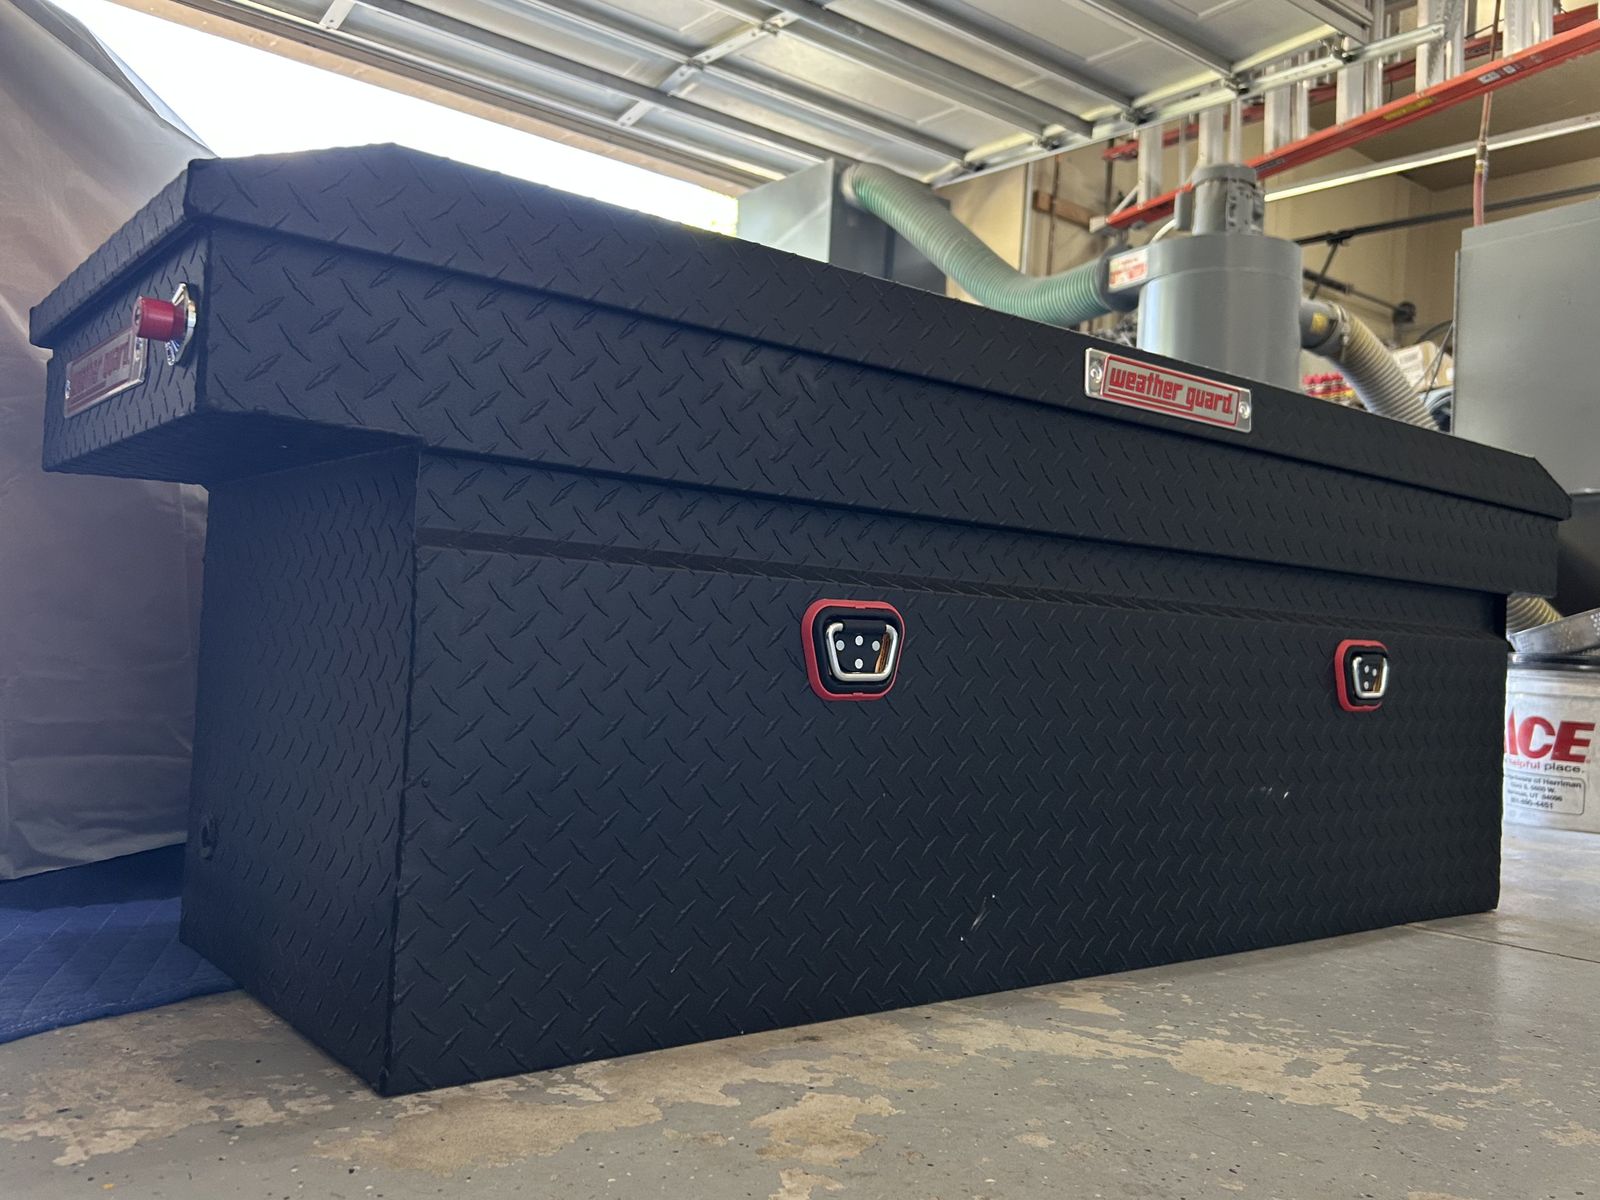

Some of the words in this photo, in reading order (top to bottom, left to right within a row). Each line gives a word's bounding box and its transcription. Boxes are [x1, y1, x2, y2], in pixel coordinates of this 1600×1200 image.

[1108, 367, 1183, 401] weather
[1504, 707, 1595, 765] ACE
[1544, 762, 1584, 774] place.
